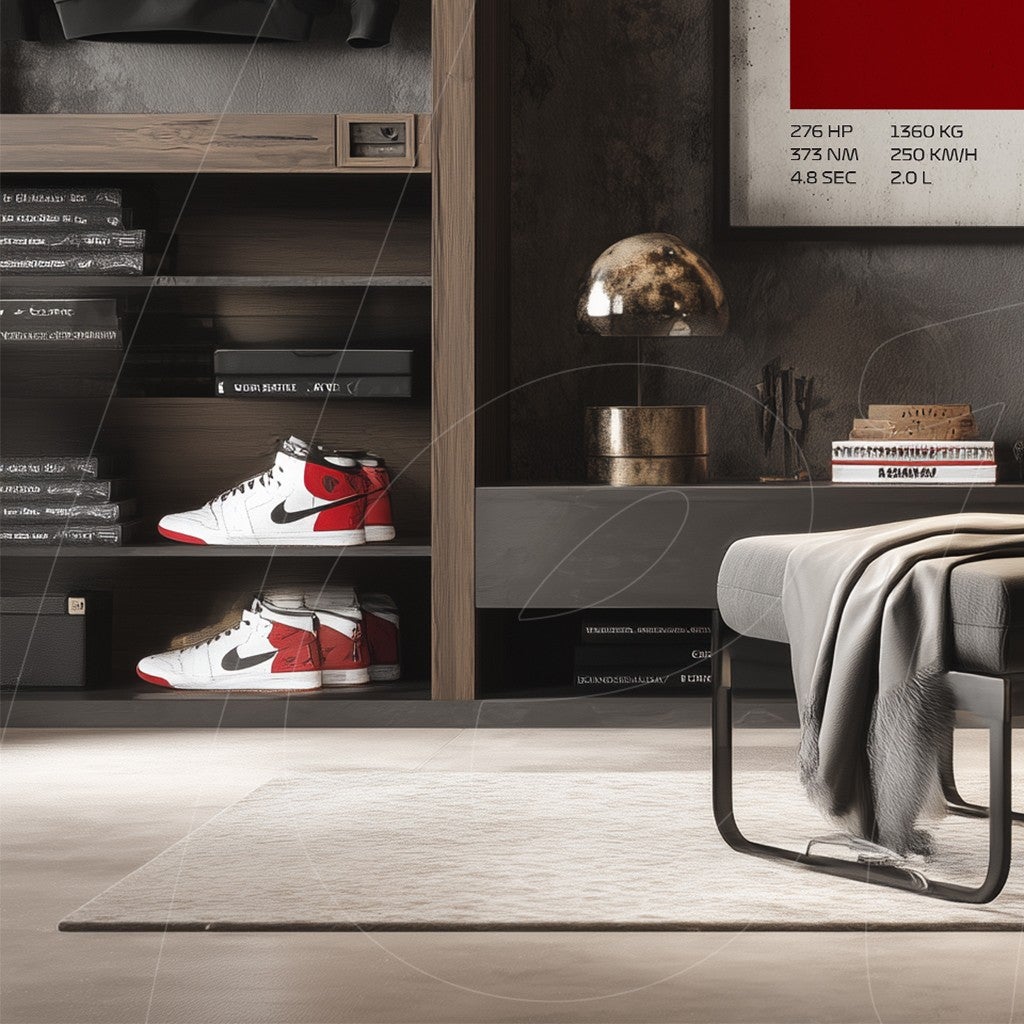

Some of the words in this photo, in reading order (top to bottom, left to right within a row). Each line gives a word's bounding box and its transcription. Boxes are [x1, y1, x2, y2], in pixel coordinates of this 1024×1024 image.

[790, 124, 824, 139] 276
[828, 124, 854, 138] HP
[890, 124, 935, 139] 1360
[939, 124, 964, 139] KG
[790, 147, 823, 161] 373
[827, 147, 859, 162] NM
[890, 147, 925, 162] 250
[929, 147, 978, 163] KM/H
[790, 170, 818, 185] 4.8
[822, 170, 857, 185] SEC
[890, 170, 918, 185] 2.0
[922, 170, 932, 185] L
